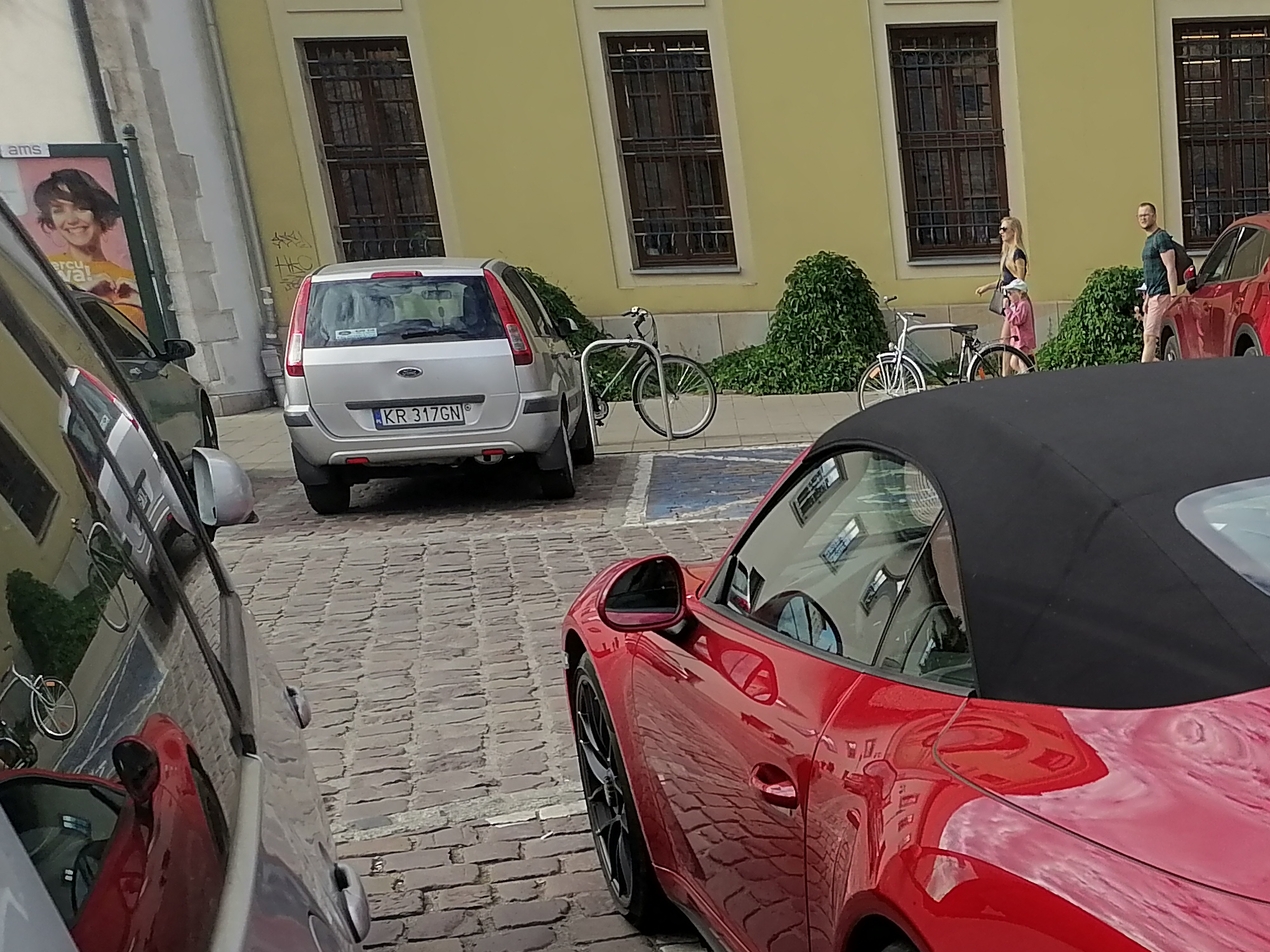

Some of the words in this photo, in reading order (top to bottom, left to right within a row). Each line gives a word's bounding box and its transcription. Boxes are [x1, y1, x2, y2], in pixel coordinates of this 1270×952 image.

[8, 144, 42, 156] ams
[50, 261, 84, 272] ercu
[383, 408, 407, 424] KR
[412, 405, 461, 422] 317GN
